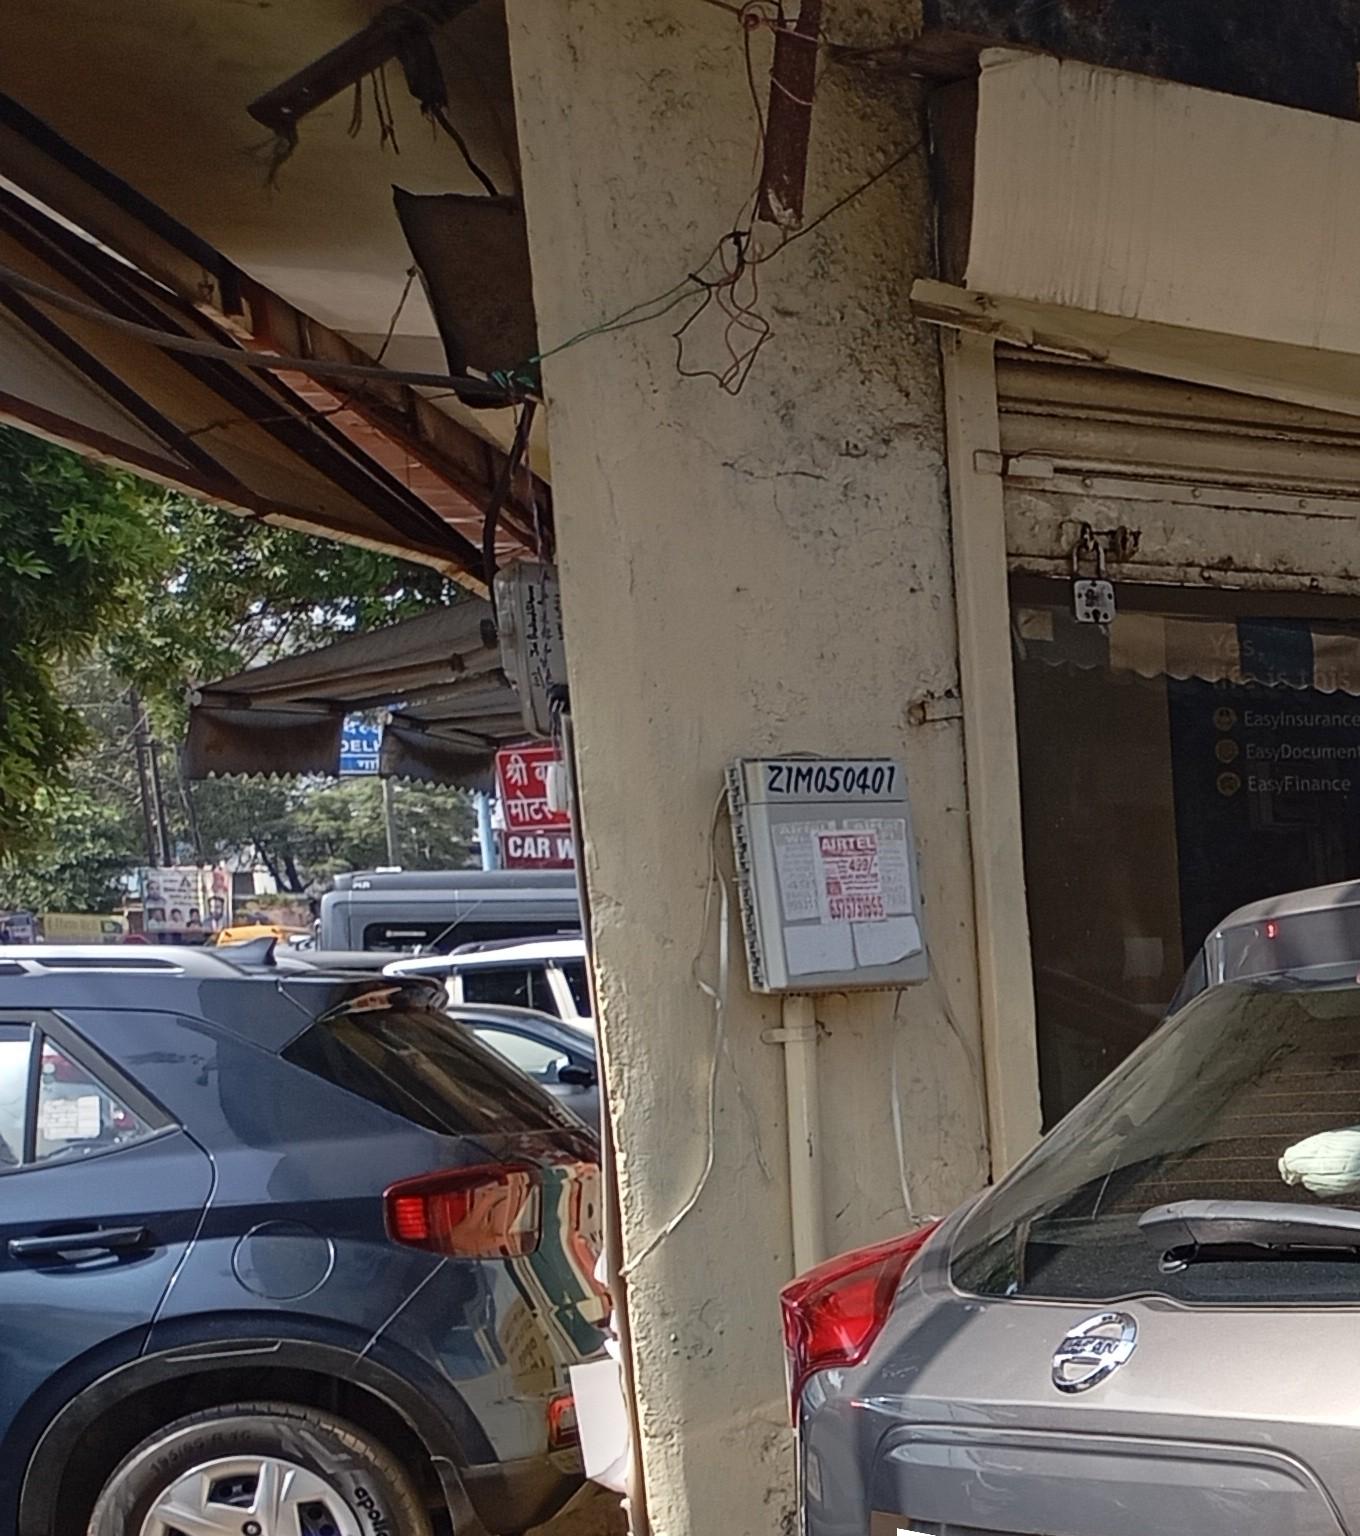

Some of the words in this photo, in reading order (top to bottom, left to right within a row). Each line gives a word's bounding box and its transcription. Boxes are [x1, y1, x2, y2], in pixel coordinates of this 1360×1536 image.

[506, 754, 528, 786] श्री
[1248, 775, 1352, 793] EasyFinance
[508, 836, 551, 859] CAR
[821, 837, 876, 851] AIRTEL
